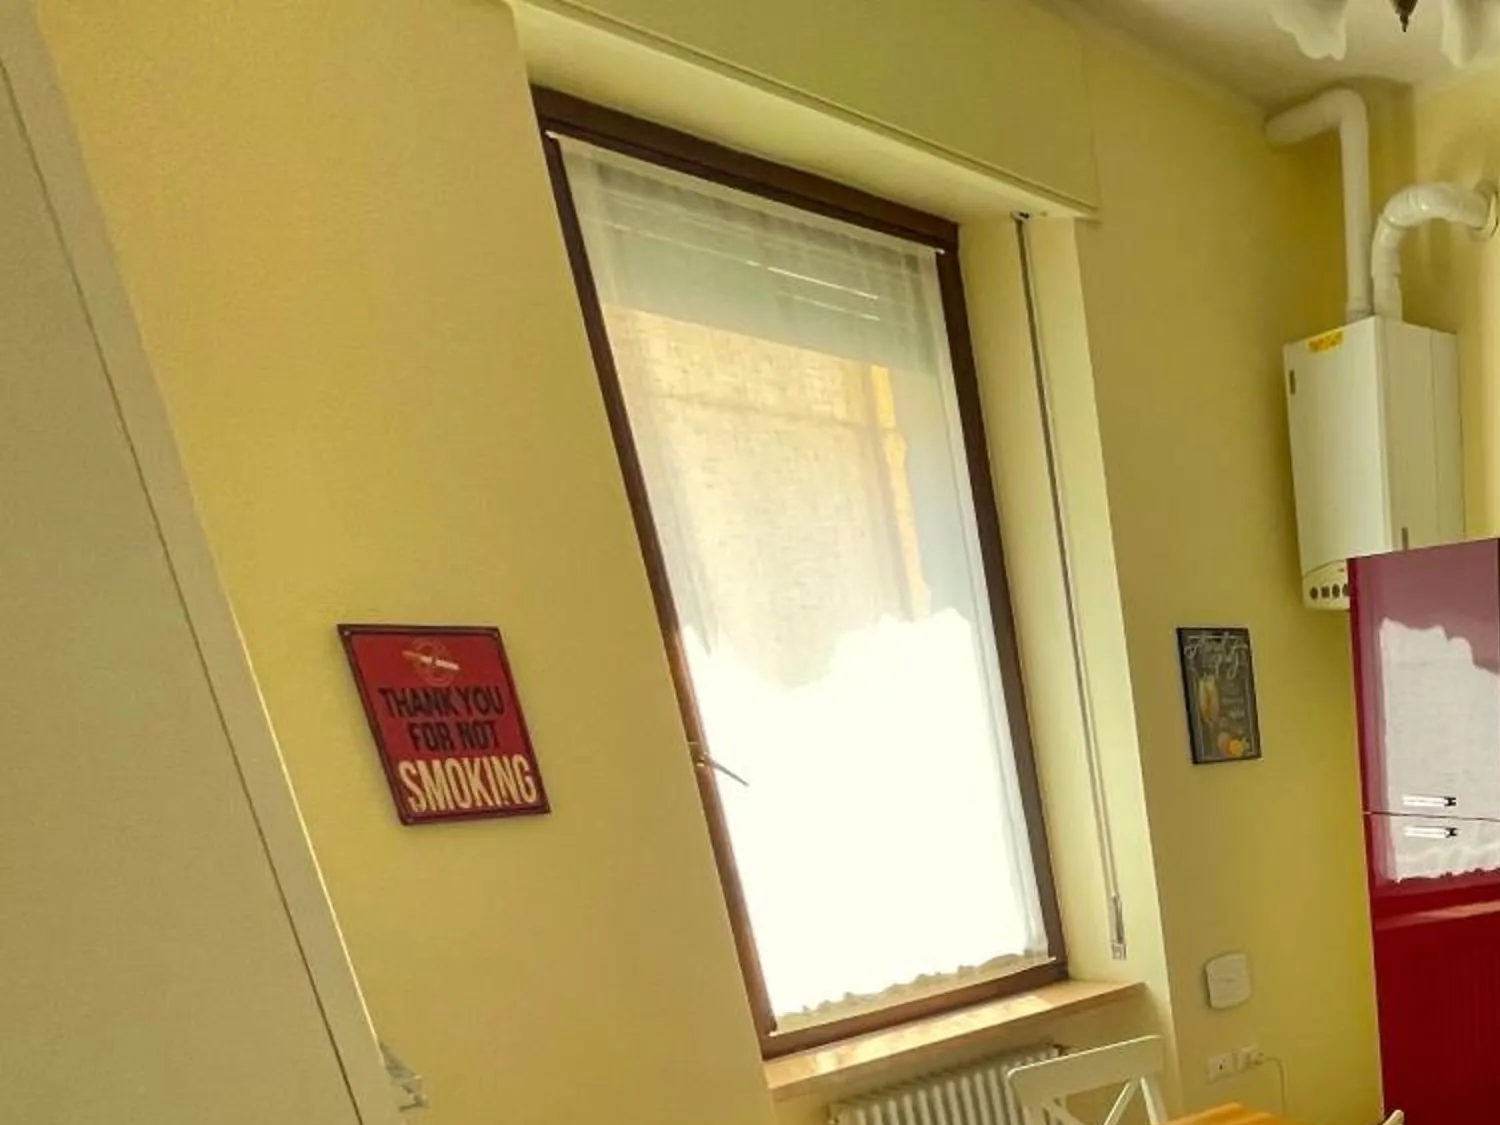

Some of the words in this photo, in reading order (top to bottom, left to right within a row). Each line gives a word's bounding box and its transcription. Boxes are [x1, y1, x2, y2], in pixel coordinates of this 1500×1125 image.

[378, 685, 459, 718] THANK
[456, 685, 505, 715] YOU
[408, 721, 455, 753] FOR
[456, 719, 501, 750] NOT
[397, 754, 538, 812] SMOKING
